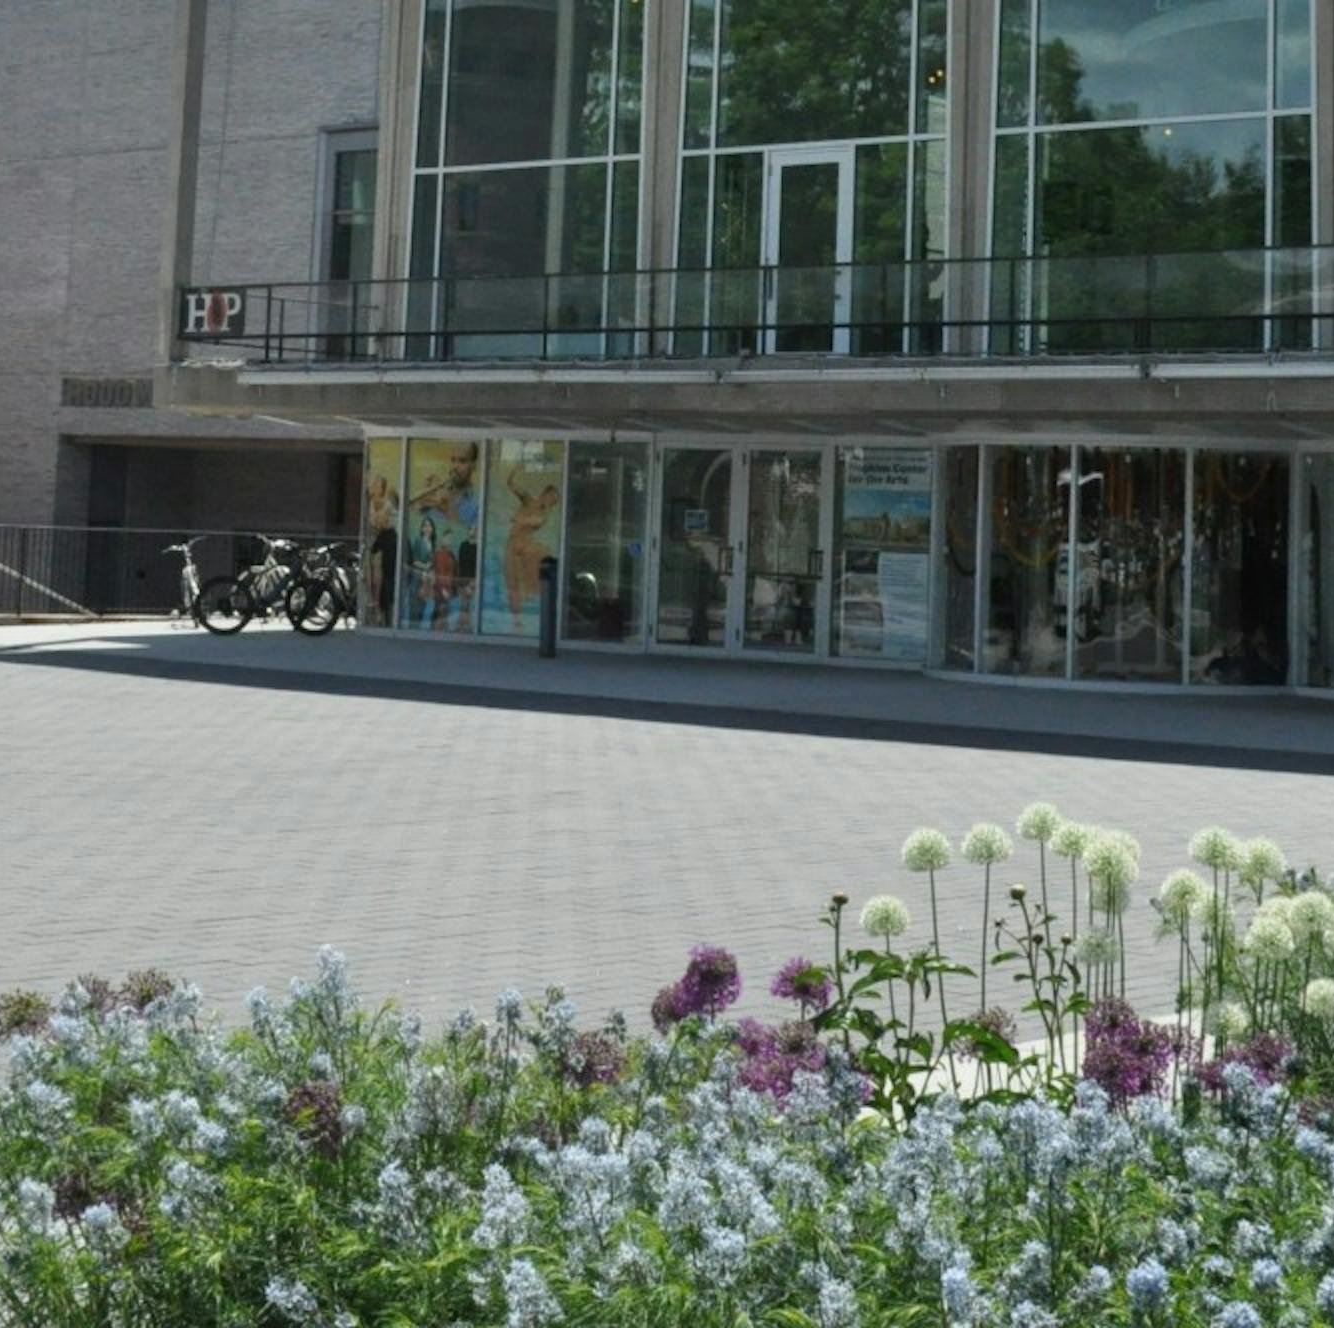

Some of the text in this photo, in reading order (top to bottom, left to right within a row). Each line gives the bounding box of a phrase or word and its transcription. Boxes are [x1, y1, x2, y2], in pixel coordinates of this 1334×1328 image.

[185, 289, 242, 334] HOP
[892, 463, 927, 474] Center
[885, 475, 908, 485] Arts
